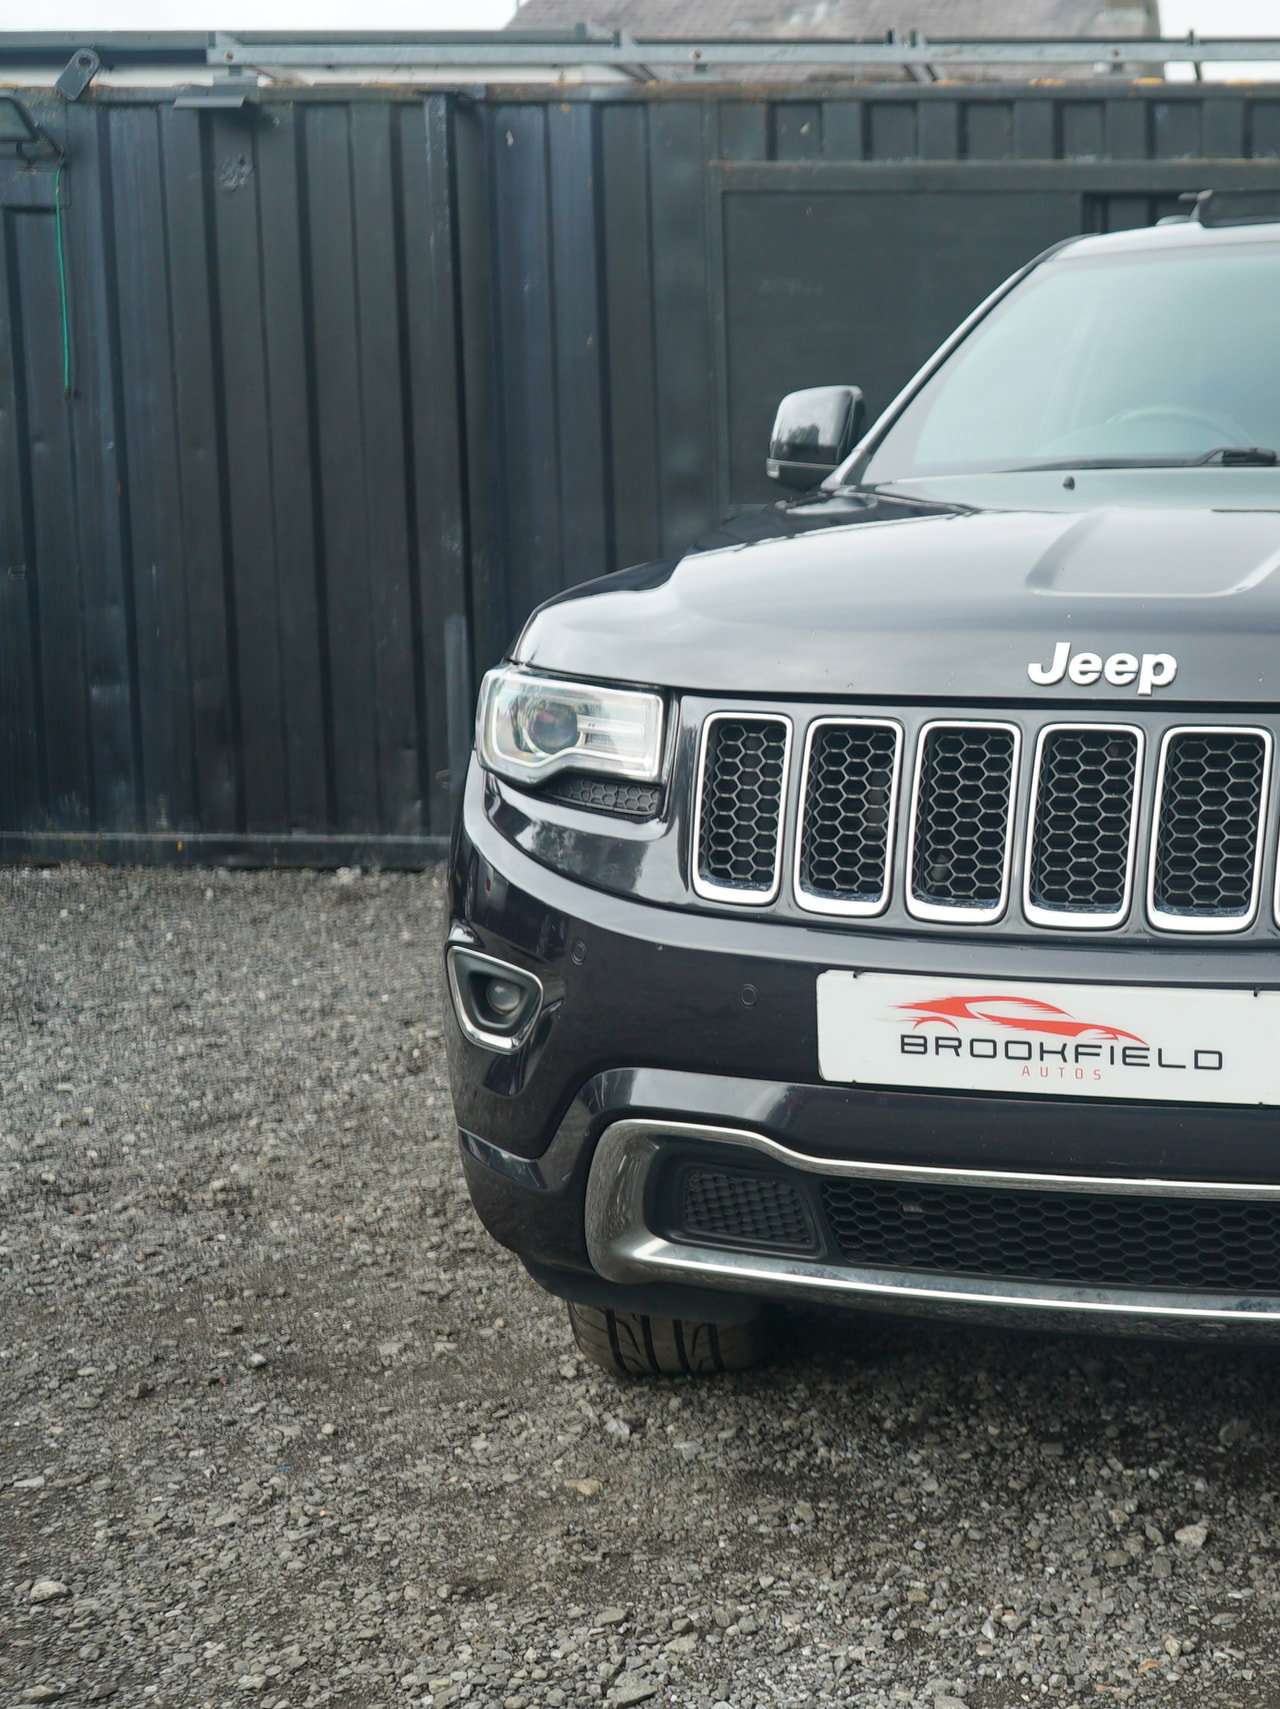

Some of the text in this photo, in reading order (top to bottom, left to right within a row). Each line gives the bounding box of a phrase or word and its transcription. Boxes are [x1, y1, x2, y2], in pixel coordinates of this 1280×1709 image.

[1028, 641, 1177, 696] Jeep
[900, 1034, 1223, 1070] BROOKFIELD
[1021, 1065, 1102, 1081] AUTOS
